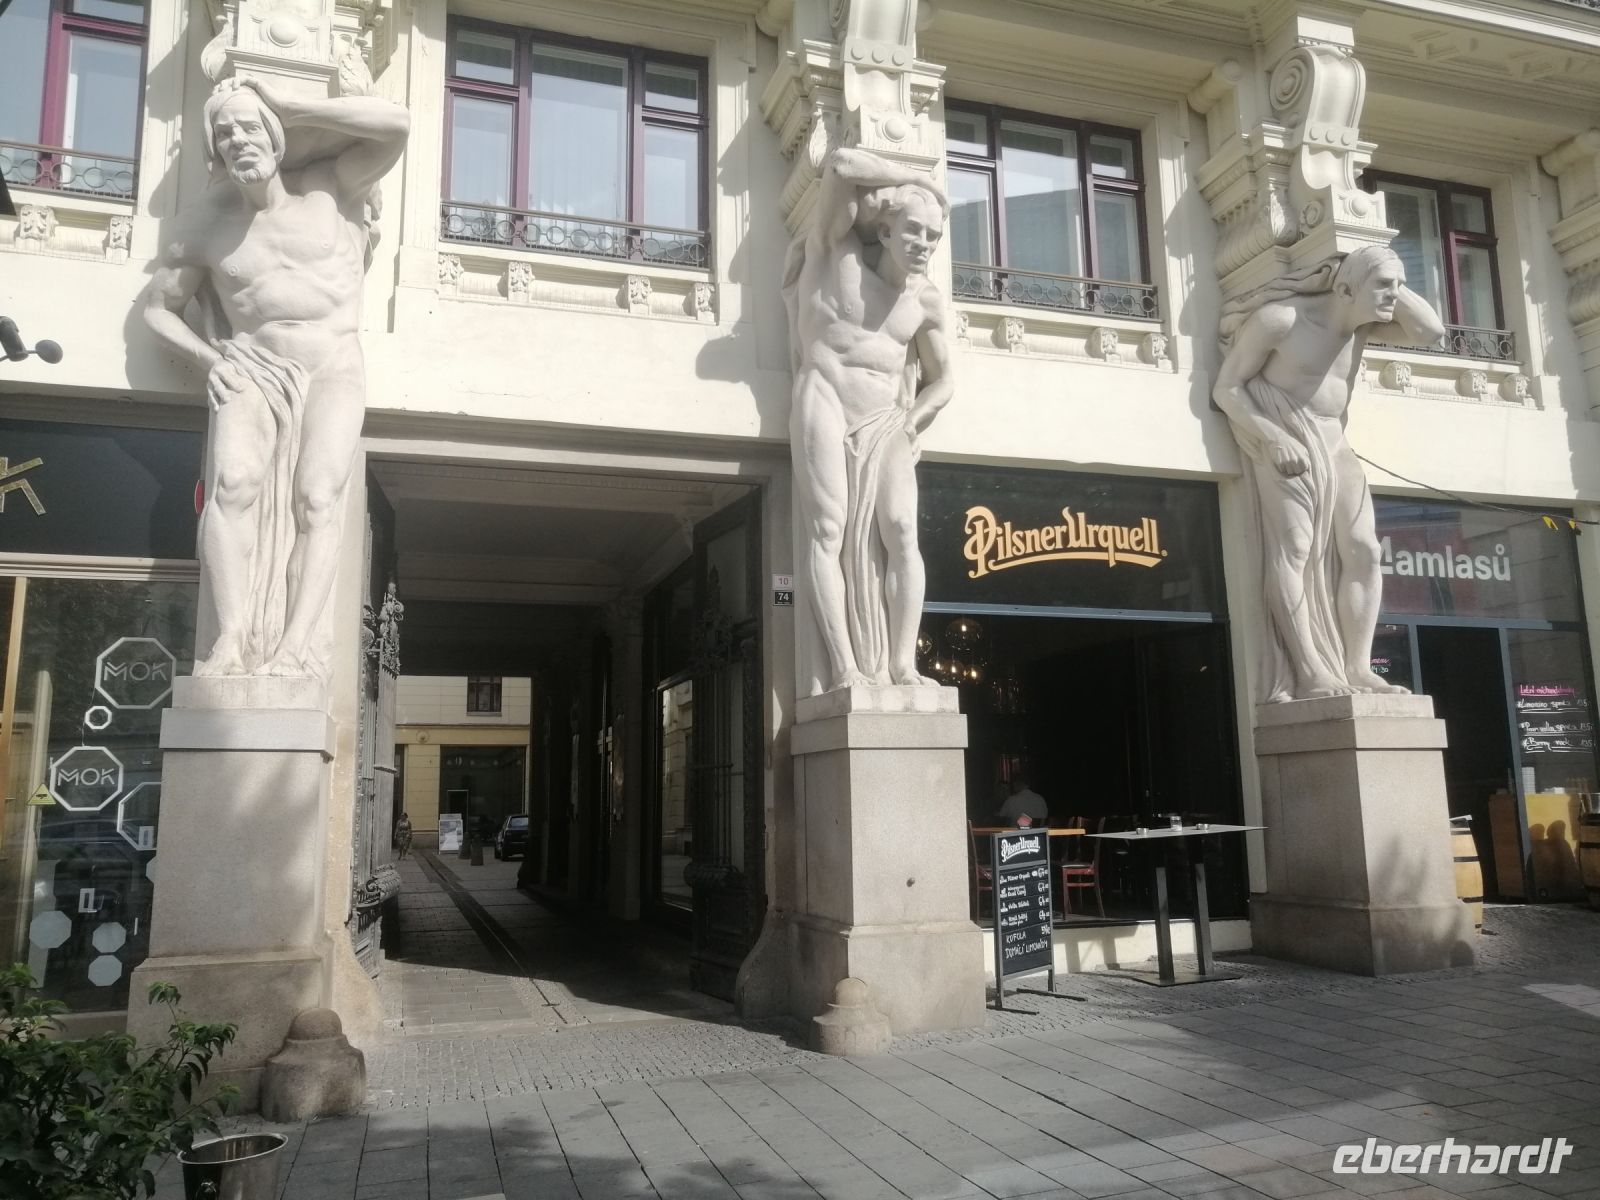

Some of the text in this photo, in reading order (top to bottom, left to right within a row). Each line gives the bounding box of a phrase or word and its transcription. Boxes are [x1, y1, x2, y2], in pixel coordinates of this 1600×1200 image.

[963, 505, 1160, 579] Pilsner Urquell
[777, 577, 789, 586] 10
[778, 592, 789, 601] 74
[103, 661, 168, 682] MOK
[57, 767, 115, 787] MOK
